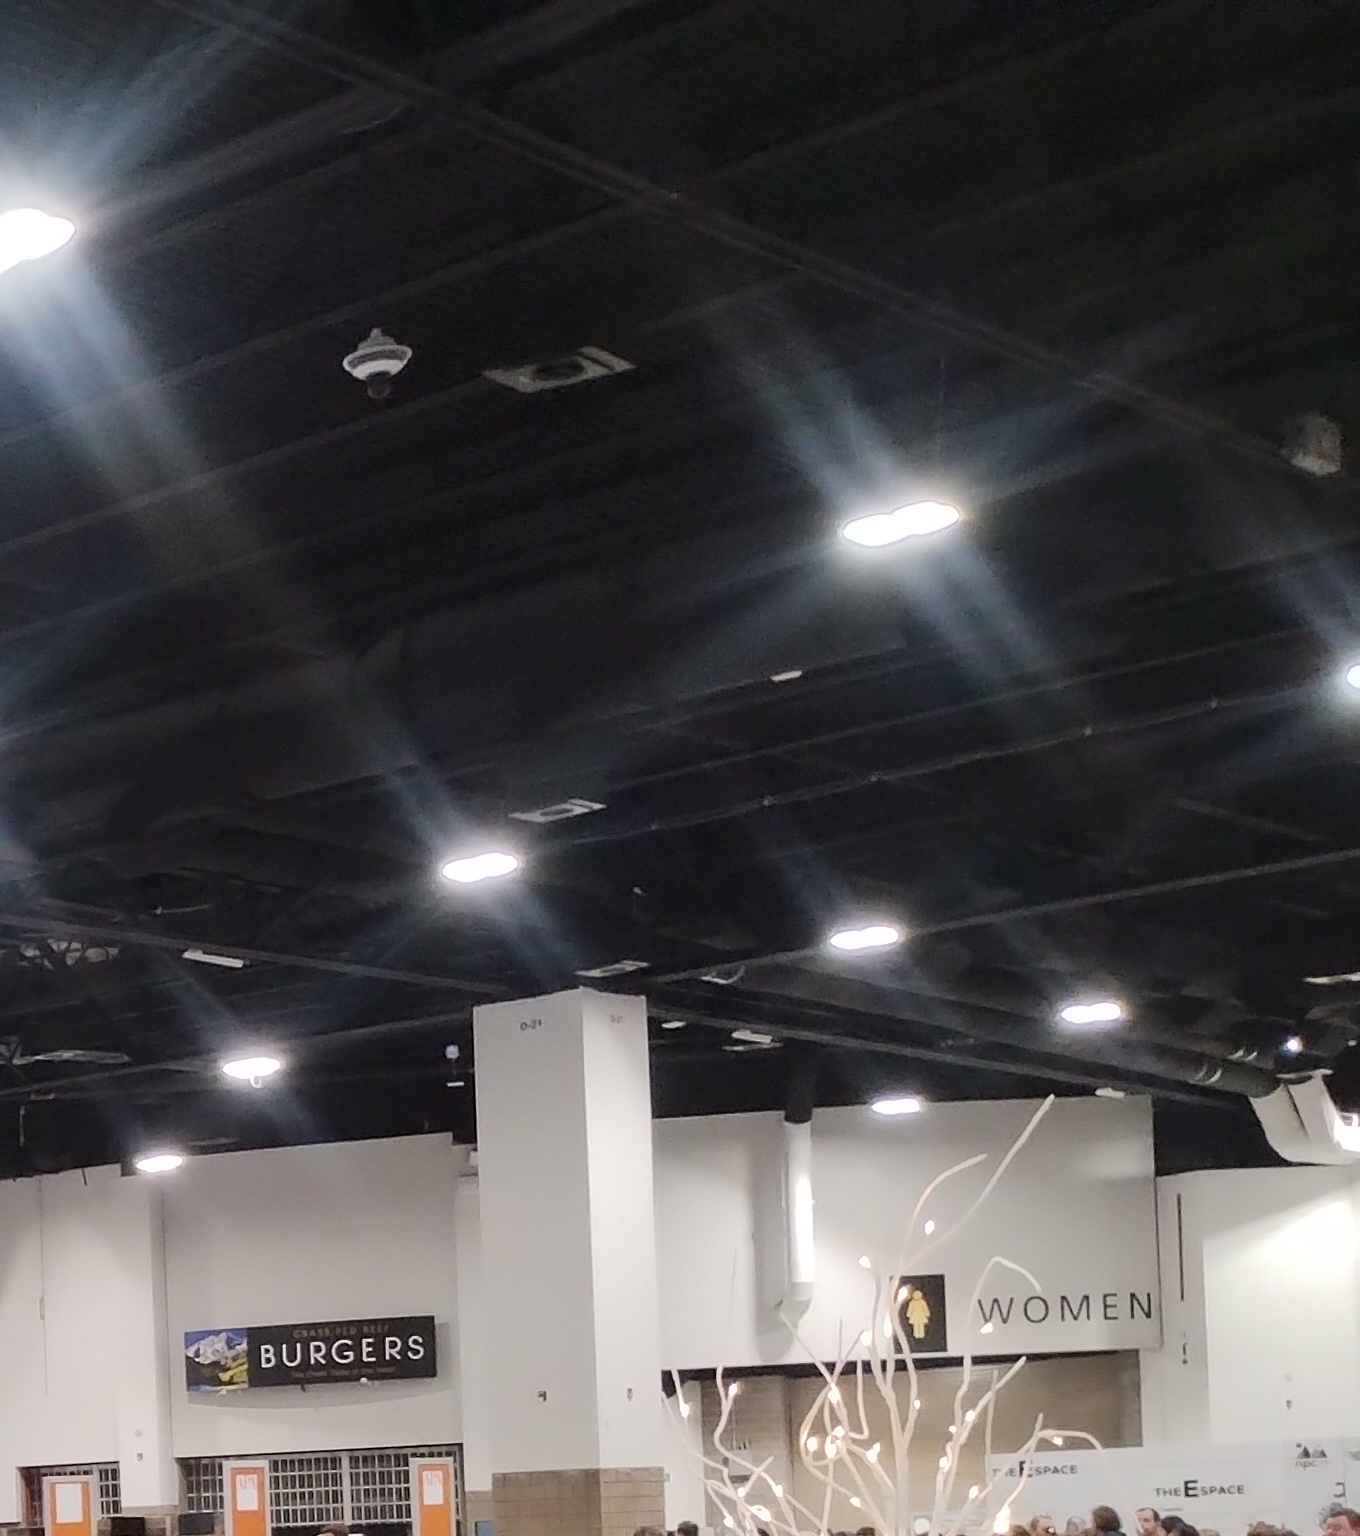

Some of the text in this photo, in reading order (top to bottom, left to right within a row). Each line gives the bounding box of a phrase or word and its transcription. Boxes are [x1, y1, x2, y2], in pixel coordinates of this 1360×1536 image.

[977, 1292, 1152, 1324] WOMEN
[260, 1335, 425, 1369] BURGERS
[992, 1467, 1016, 1478] TE
